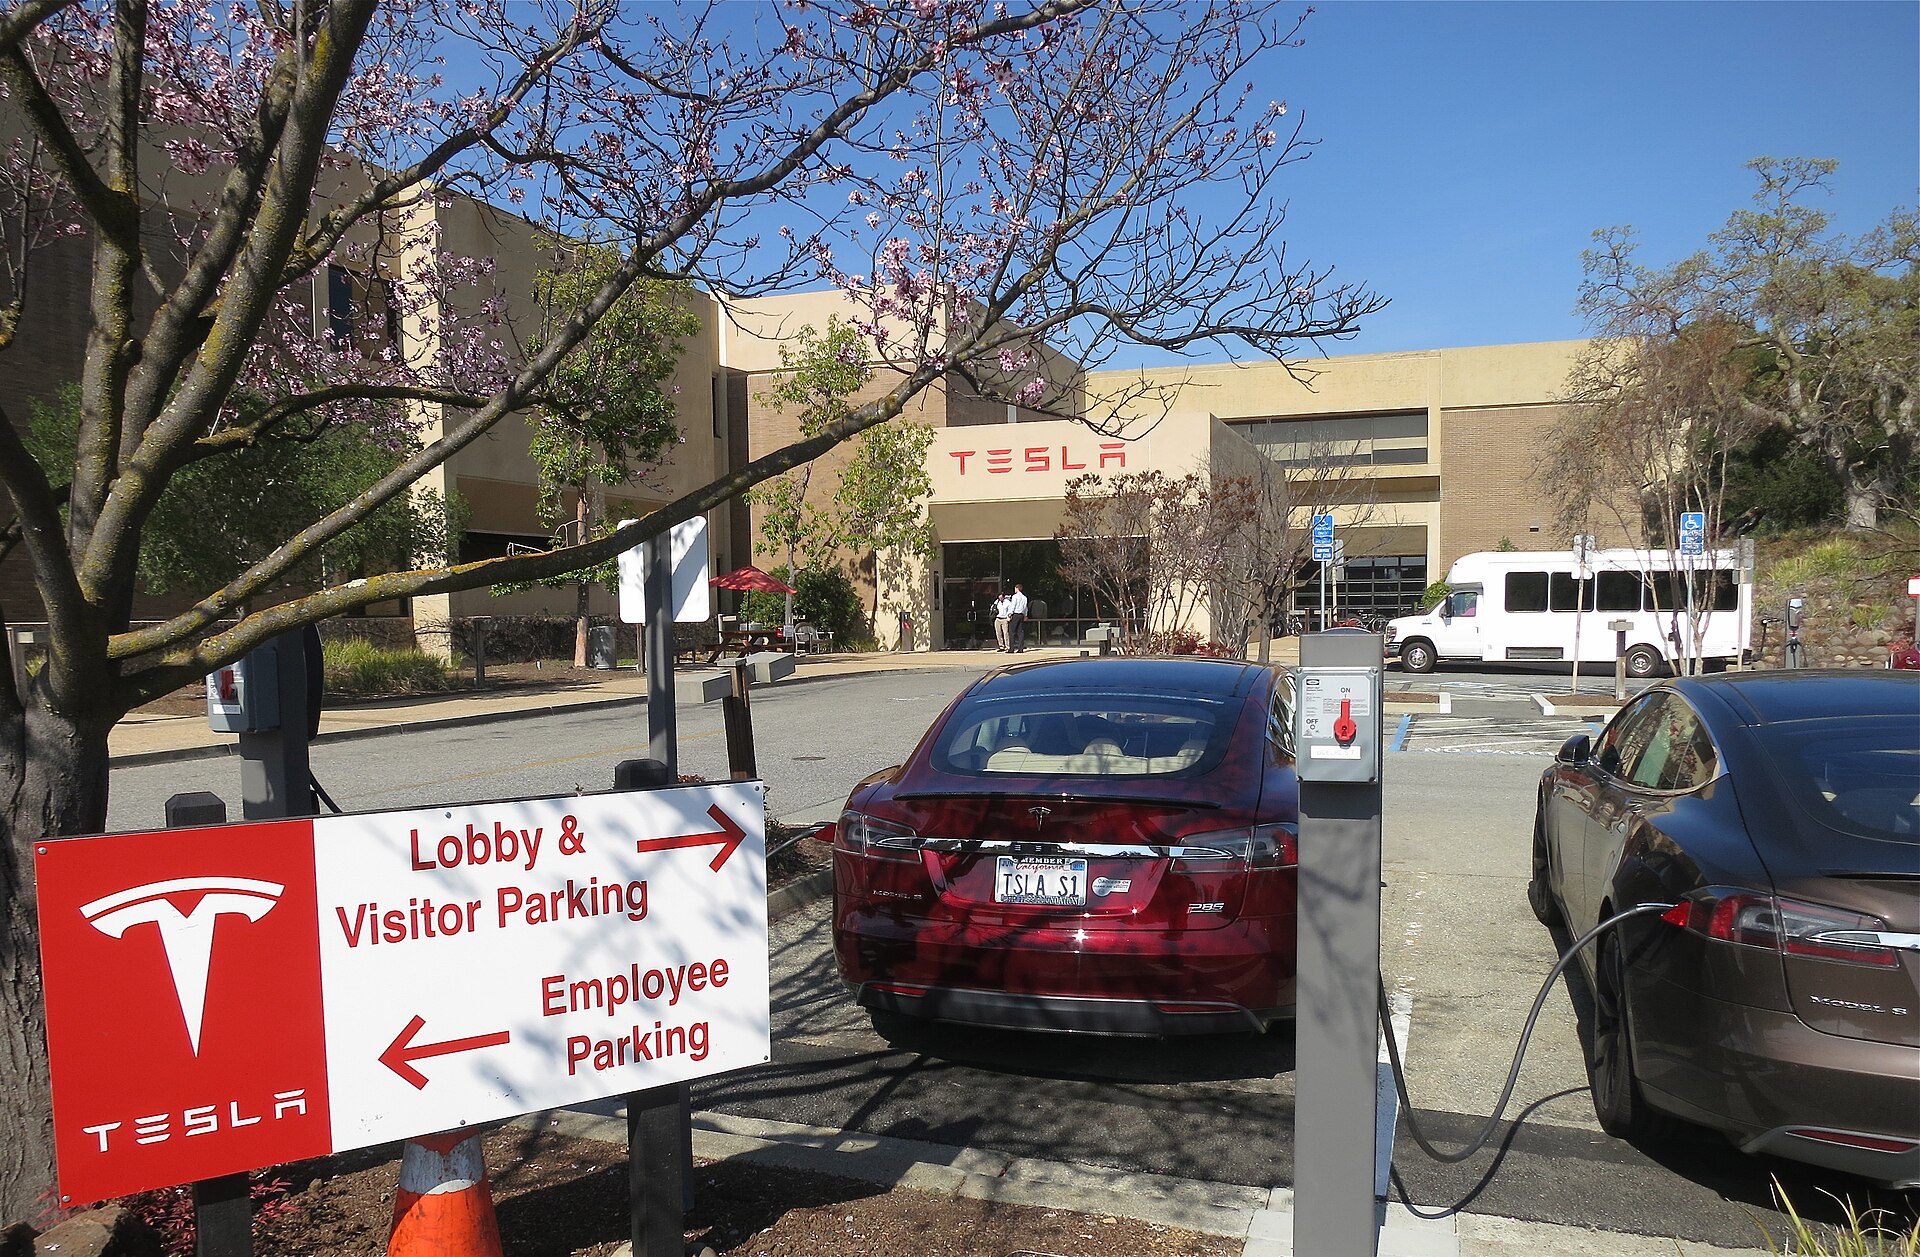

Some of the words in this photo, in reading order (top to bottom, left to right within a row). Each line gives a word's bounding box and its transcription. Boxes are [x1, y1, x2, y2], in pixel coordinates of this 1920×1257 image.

[949, 442, 1126, 475] TESLA
[411, 820, 543, 871] Lobby
[559, 816, 586, 855] &
[1015, 863, 1065, 874] California
[336, 893, 482, 948] Visitor
[498, 877, 648, 928] Parking
[1003, 873, 1046, 896] TSLA
[1058, 875, 1080, 897] S1
[542, 959, 729, 1016] Employee
[1810, 995, 1886, 1013] MODEL
[1891, 1006, 1907, 1016] S
[568, 1021, 711, 1076] Parking
[83, 1088, 307, 1153] TESLA
